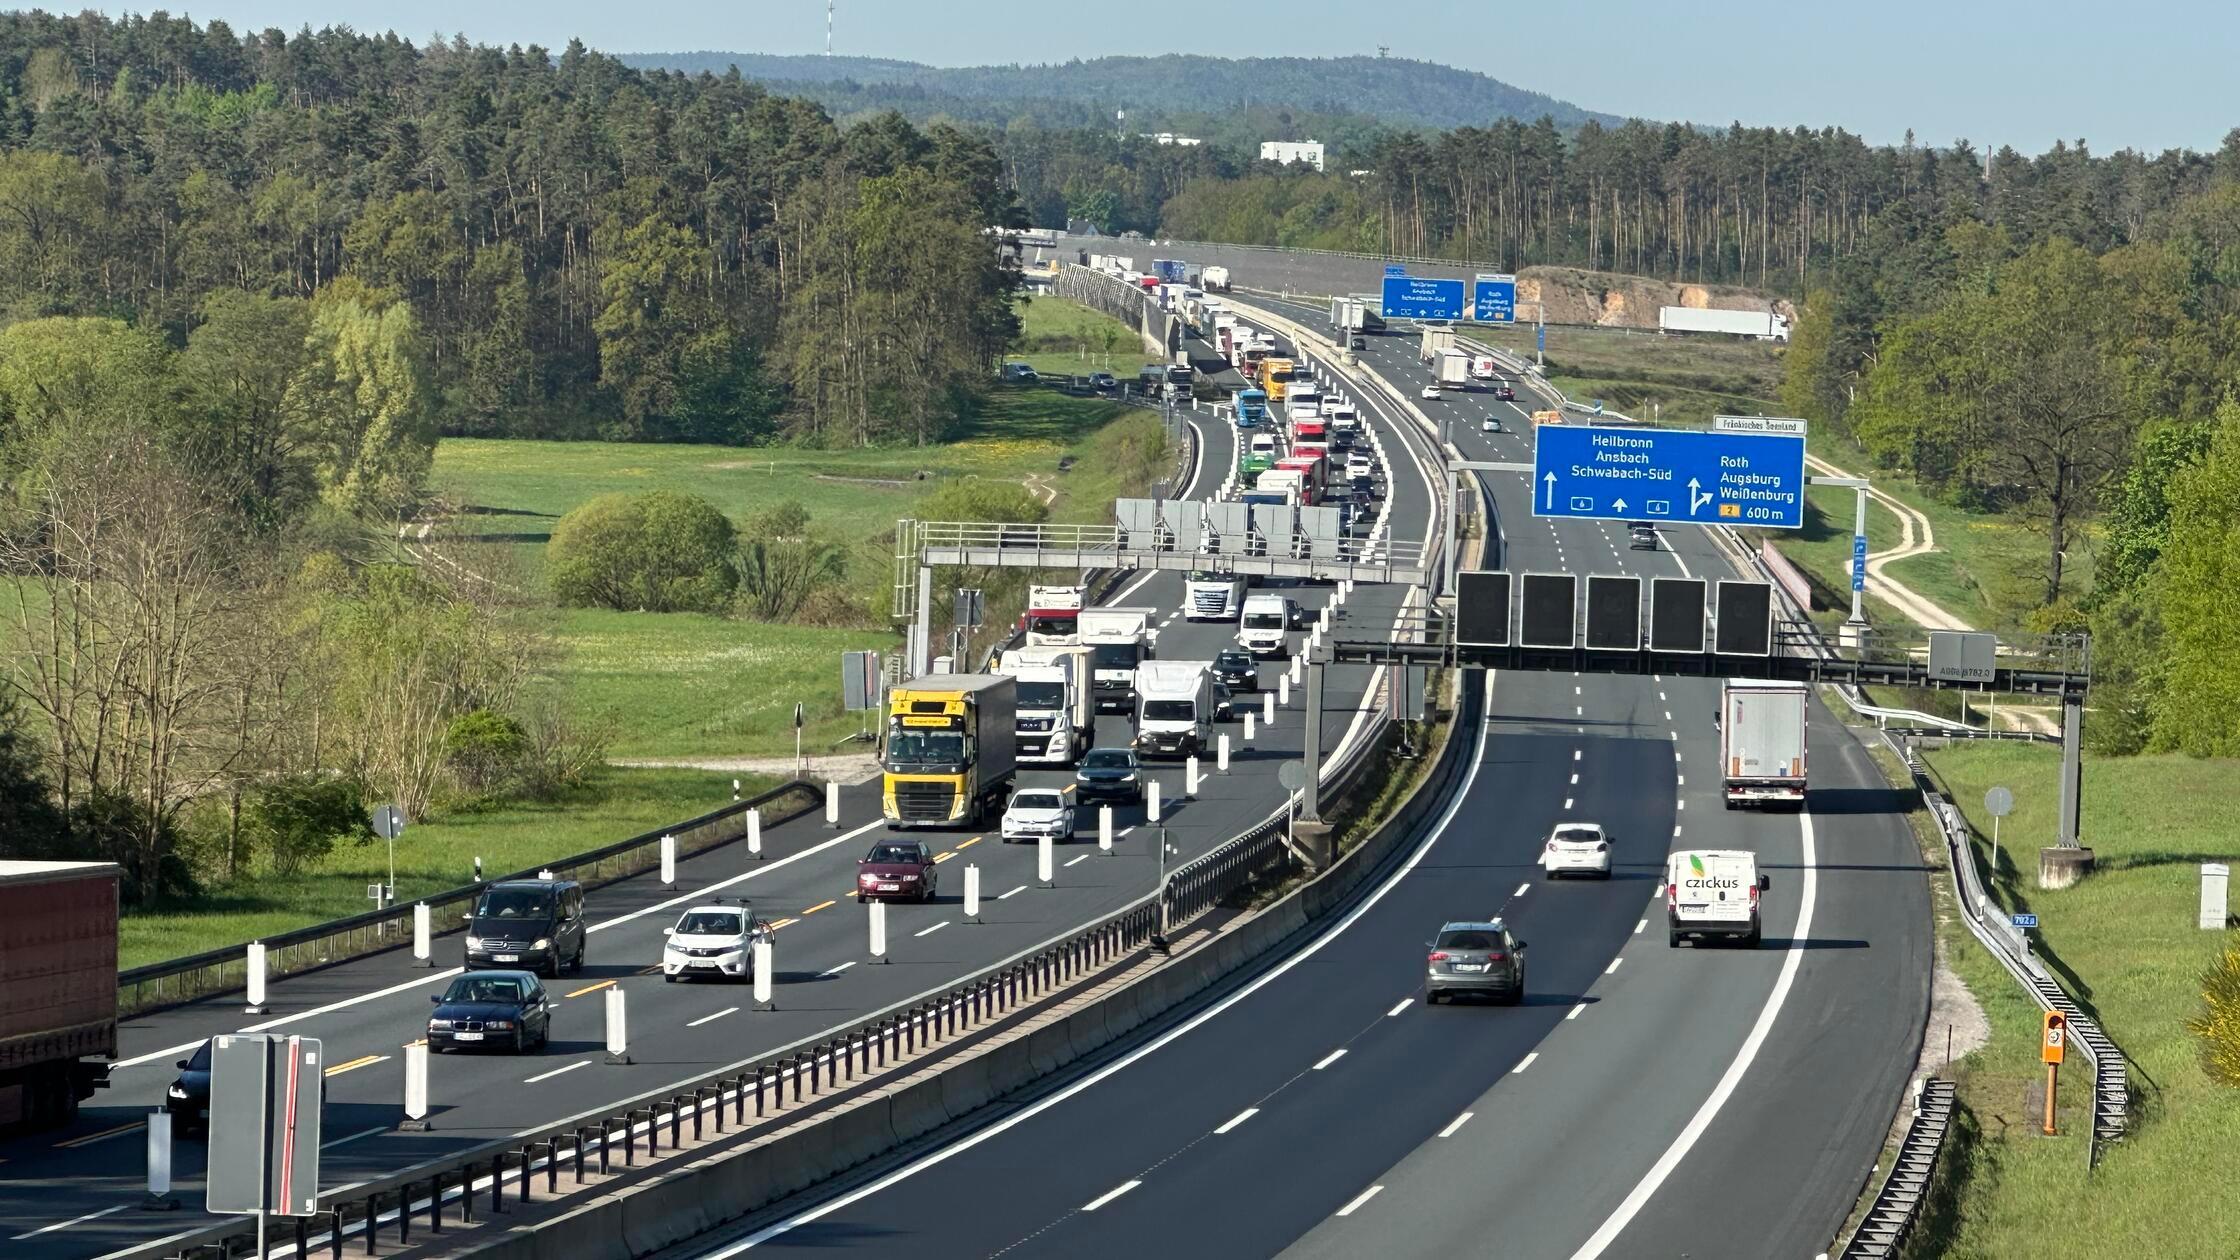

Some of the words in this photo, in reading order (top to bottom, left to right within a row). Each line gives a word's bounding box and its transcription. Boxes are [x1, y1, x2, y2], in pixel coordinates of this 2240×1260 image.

[1592, 434, 1653, 449] Heilbronn
[1595, 450, 1649, 464] Ansbach
[1720, 455, 1749, 468] Roth
[1571, 464, 1672, 480] Schwabach-Süd
[1720, 471, 1781, 488] Augsburg
[1720, 486, 1794, 504] Weißenburg
[1727, 506, 1734, 514] 2
[1746, 507, 1770, 519] 600
[1771, 510, 1784, 519] m
[1686, 876, 1739, 889] czickus
